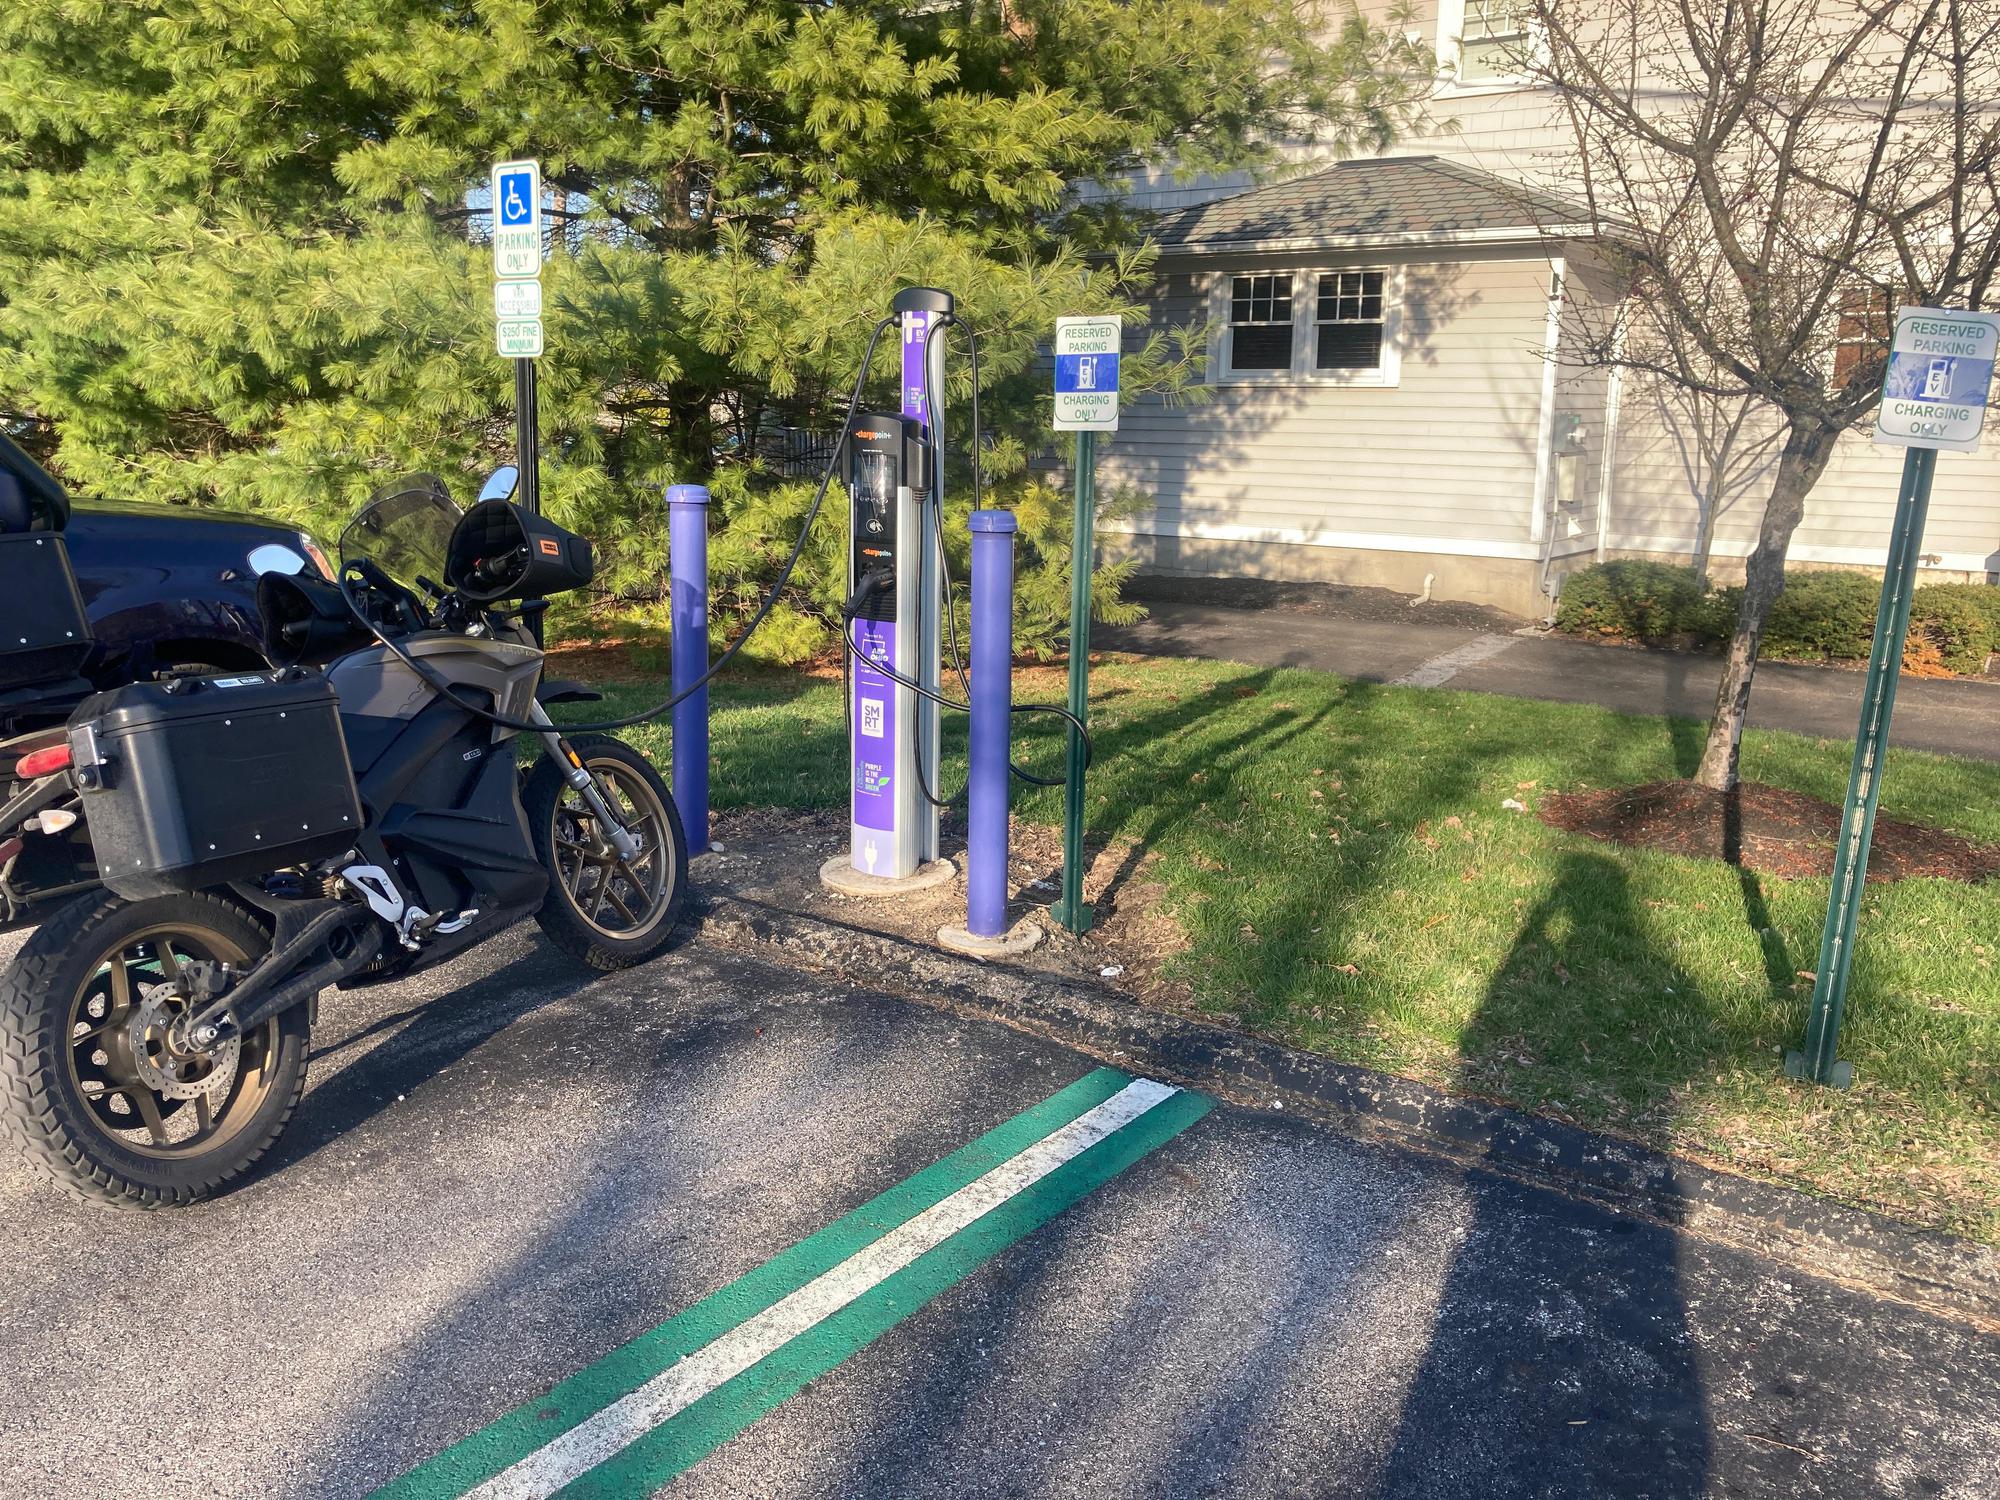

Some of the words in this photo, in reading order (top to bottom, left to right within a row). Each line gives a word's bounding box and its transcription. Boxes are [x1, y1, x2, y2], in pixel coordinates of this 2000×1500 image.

[498, 232, 536, 250] PARKING
[507, 254, 528, 268] ONLY
[500, 300, 537, 311] ACCESSIBLE
[502, 326, 520, 337] $250
[523, 326, 537, 336] FINE
[1065, 327, 1112, 338] RESERVED
[1910, 321, 1986, 339] RESERVED
[507, 339, 533, 350] MINIMUM
[1069, 342, 1107, 352] PARKING
[1913, 339, 1976, 356] PARKING
[1063, 395, 1109, 405] CHARGING
[1075, 409, 1098, 419] ONLY
[1894, 403, 1970, 421] CHARGING
[865, 705, 880, 717] SM
[865, 716, 879, 728] RT
[865, 763, 882, 771] PURPLE
